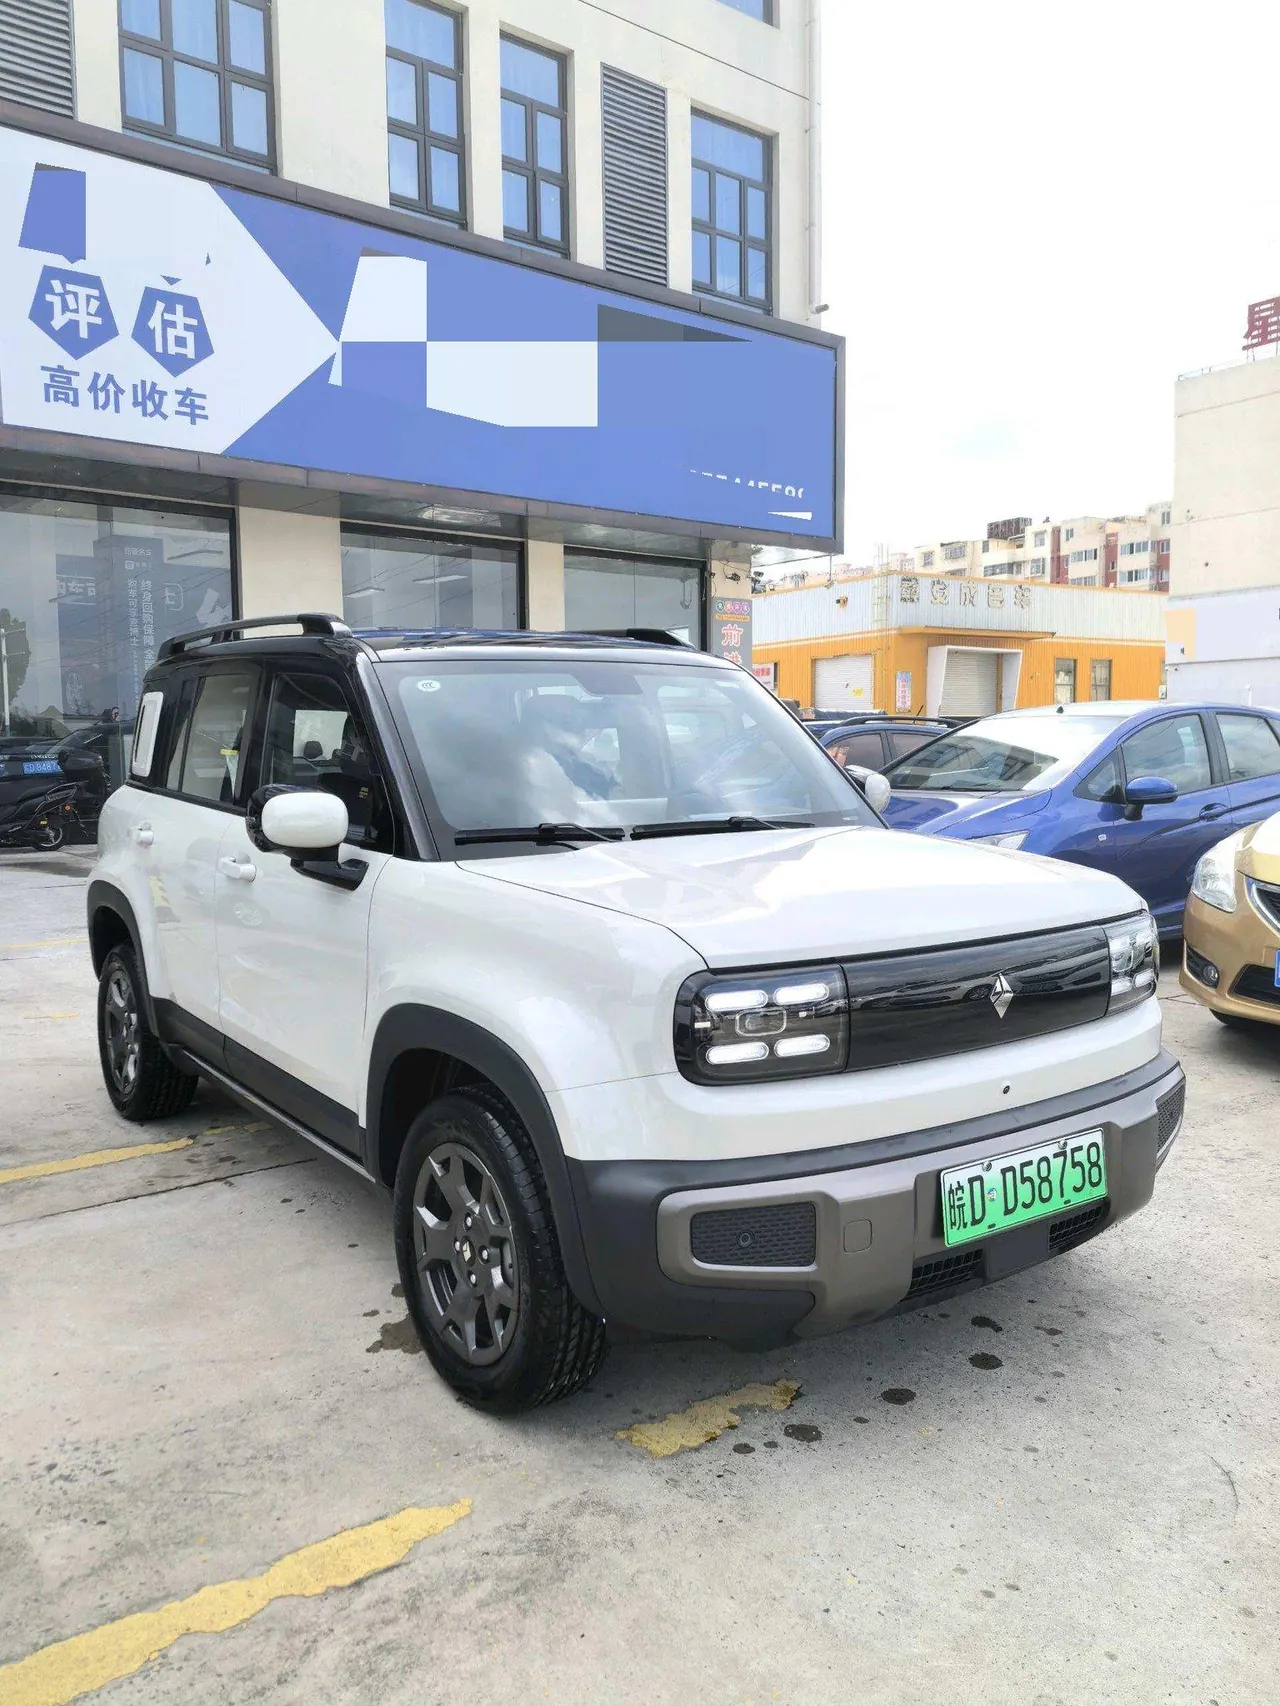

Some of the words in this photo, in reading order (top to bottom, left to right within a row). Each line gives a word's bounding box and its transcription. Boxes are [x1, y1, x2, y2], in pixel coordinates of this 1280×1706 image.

[45, 280, 198, 360] 评估
[41, 364, 209, 426] 高价收车
